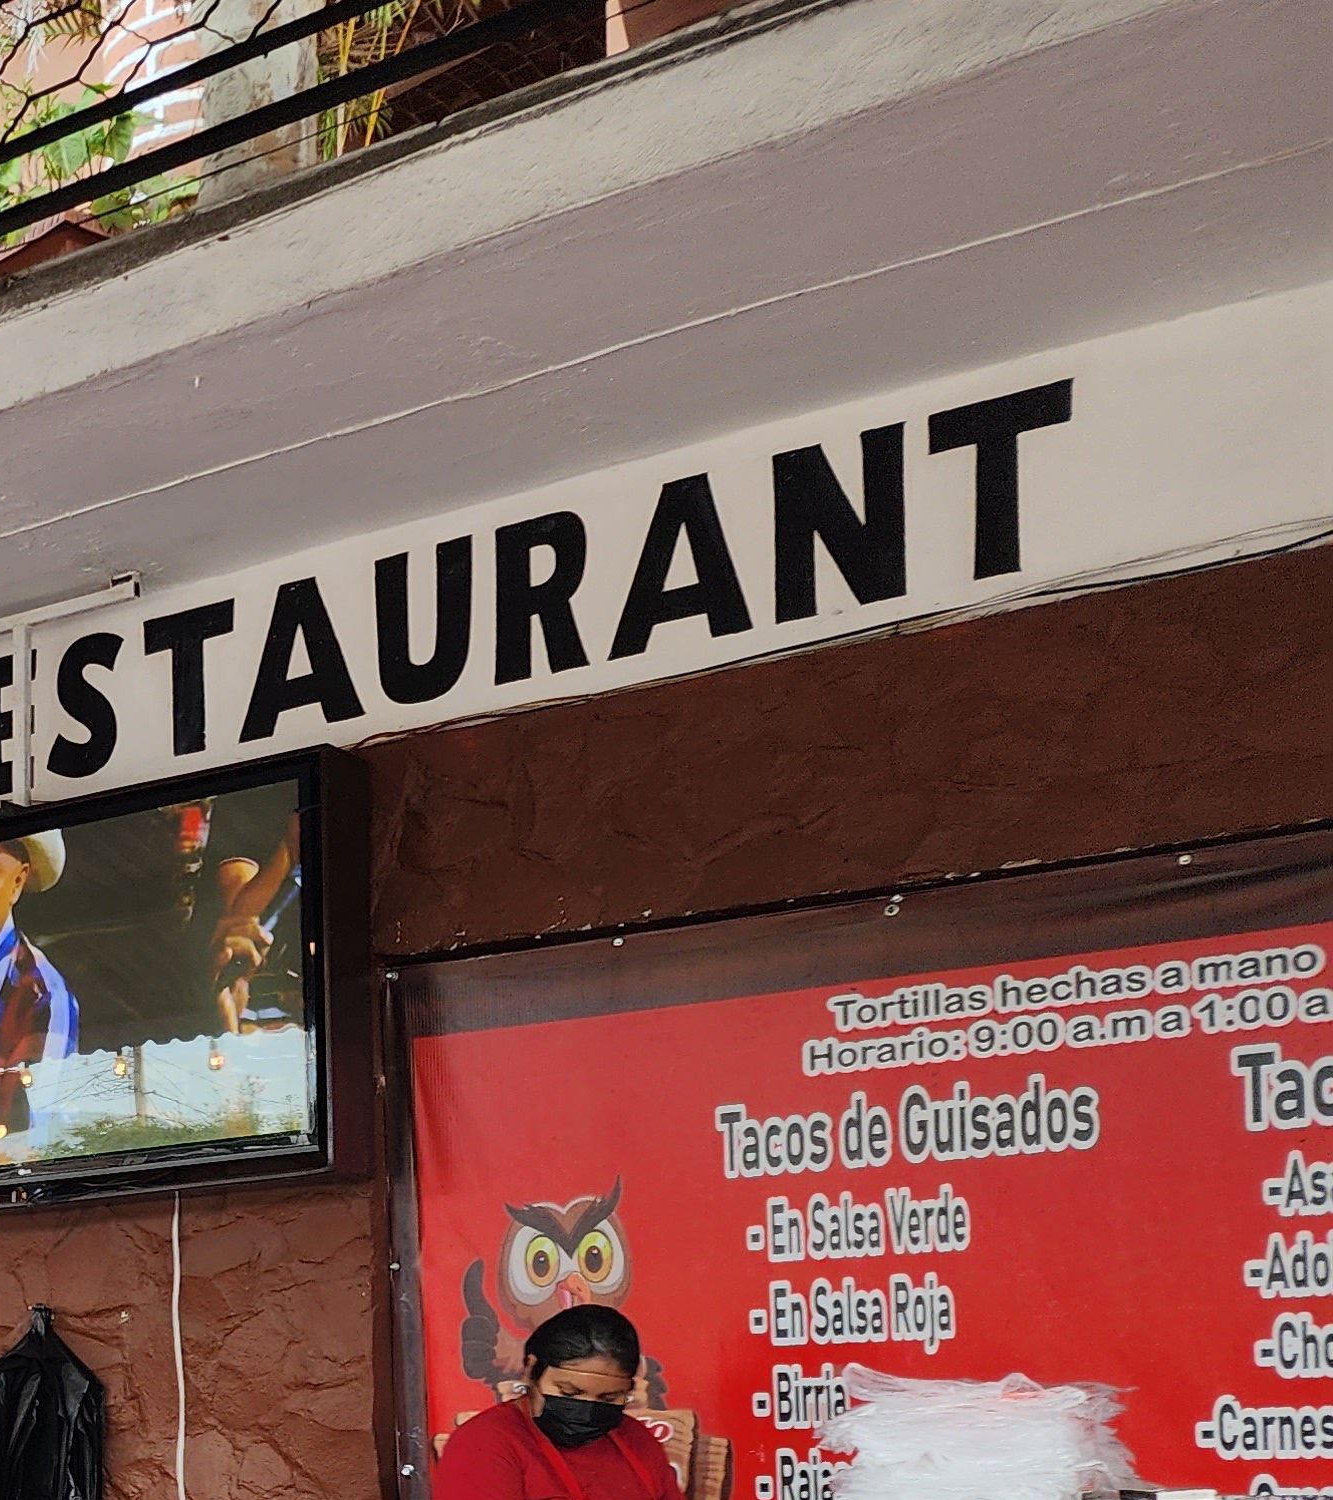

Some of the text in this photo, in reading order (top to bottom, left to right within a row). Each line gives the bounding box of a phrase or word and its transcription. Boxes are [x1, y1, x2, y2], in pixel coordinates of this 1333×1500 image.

[834, 948, 1318, 1028] Tortillas hechas a mano
[808, 1031, 962, 1071] Horario:
[974, 1017, 1060, 1054] 9:00
[1072, 1012, 1146, 1043] a.m
[1161, 1008, 1185, 1033] a
[1198, 992, 1290, 1028] 1:00
[720, 1078, 1096, 1171] Tacos de Guisados
[771, 1203, 803, 1254] En
[811, 1198, 882, 1252] Salsa
[886, 1189, 967, 1247] Verde
[774, 1286, 805, 1339] En
[814, 1281, 884, 1336] Salsa
[894, 1278, 951, 1350] Roja
